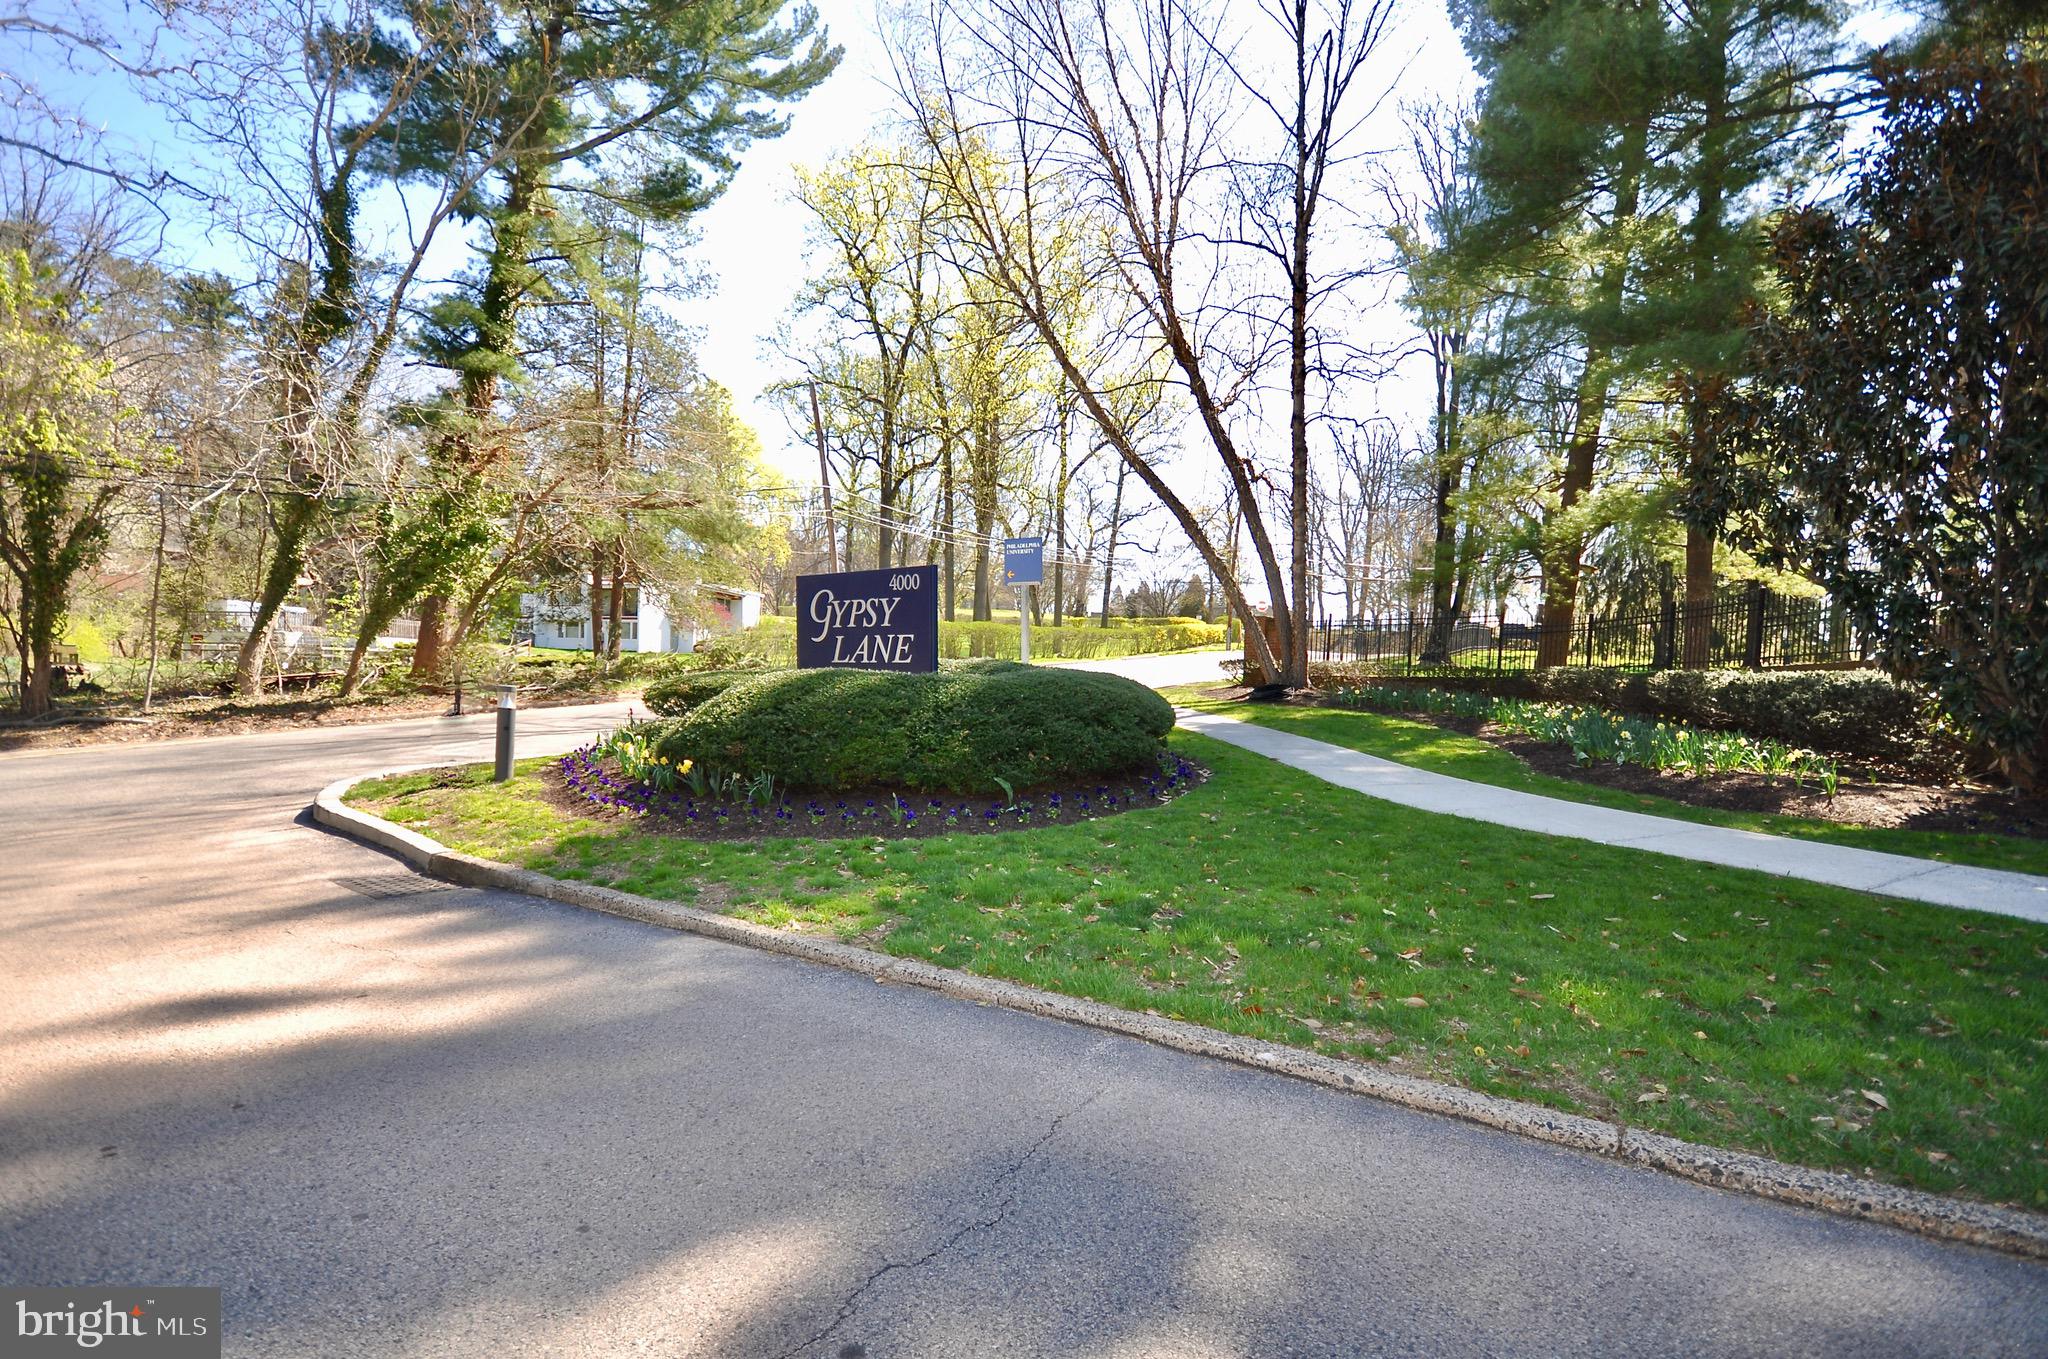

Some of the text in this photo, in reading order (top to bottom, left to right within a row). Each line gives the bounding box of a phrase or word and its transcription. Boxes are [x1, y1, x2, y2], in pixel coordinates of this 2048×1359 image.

[889, 573, 920, 591] 4000
[810, 589, 901, 643] GYPSY
[831, 634, 914, 664] LANE
